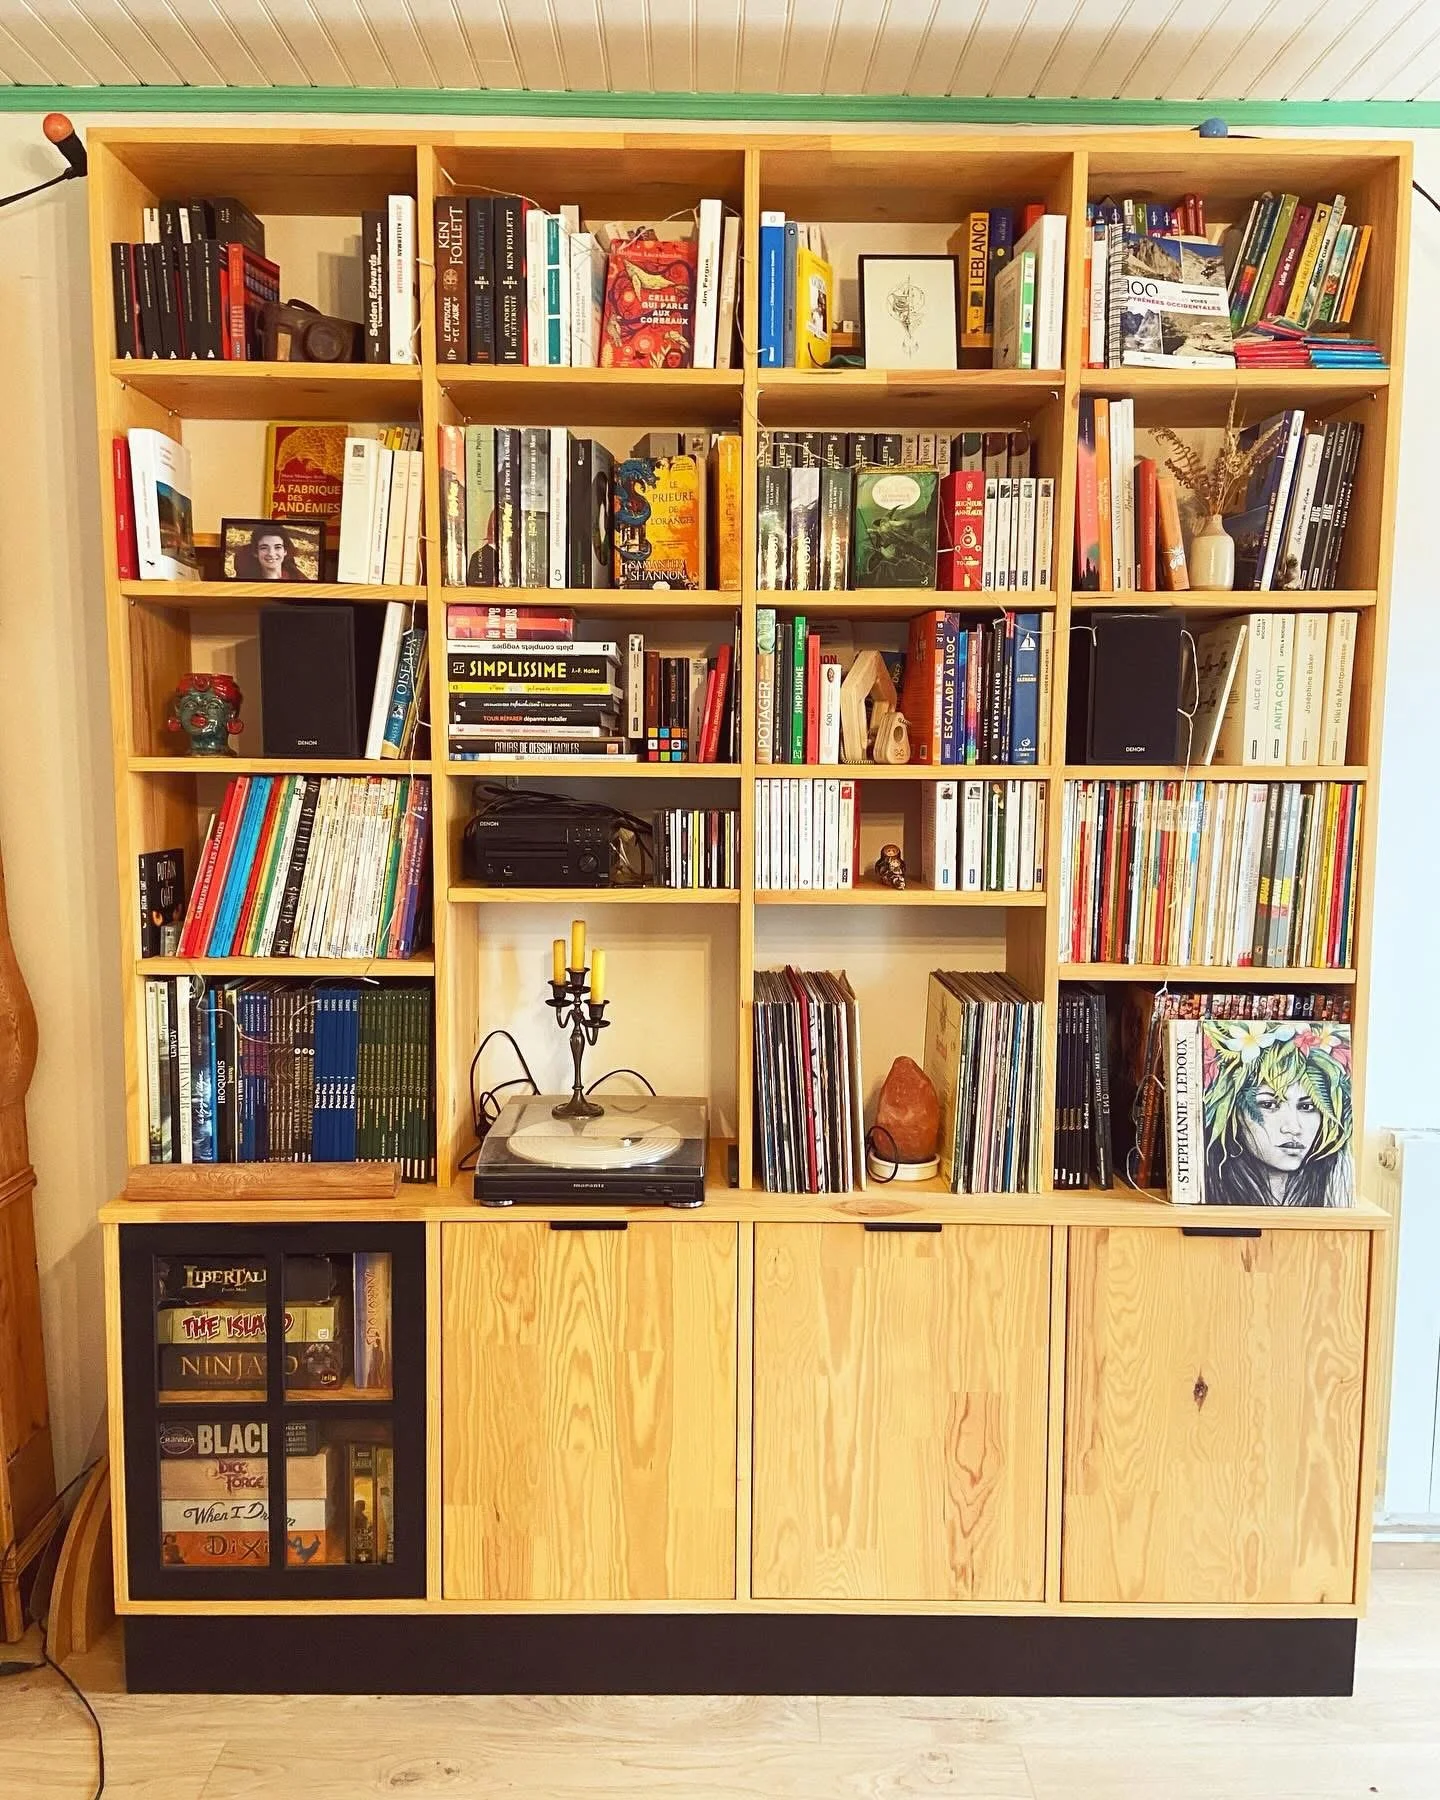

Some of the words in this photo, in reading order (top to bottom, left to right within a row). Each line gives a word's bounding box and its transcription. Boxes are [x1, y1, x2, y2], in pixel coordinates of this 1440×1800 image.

[439, 222, 449, 248] KEN
[450, 206, 463, 264] FOLLETT
[642, 302, 657, 310] QUI
[660, 302, 688, 310] PARLE
[648, 294, 676, 302] CELLE
[1166, 302, 1221, 311] OCCIDENTALES
[640, 316, 688, 325] CORBEAUX
[288, 484, 342, 496] FABRIQUE
[288, 494, 303, 502] DES
[272, 499, 341, 513] PANDÉMIES
[668, 506, 678, 514] DE
[1310, 506, 1322, 523] BUG
[1322, 504, 1334, 521] BUG
[631, 560, 687, 570] SAMANTHA
[631, 571, 685, 581] SHANNON
[501, 623, 518, 639] des
[946, 636, 956, 664] BLOC
[397, 637, 418, 695] OISEAUX
[469, 660, 567, 678] SIMPLISSIME
[946, 667, 954, 678] À
[1338, 643, 1348, 696] Montparnasse
[796, 666, 804, 713] SIMPLISSIME
[1276, 665, 1287, 696] CONTI
[944, 680, 954, 738] ESCALADE
[1336, 696, 1342, 707] de
[757, 680, 772, 747] POTAGER
[1274, 698, 1284, 730] ANITA
[494, 742, 518, 753] COURS
[519, 742, 528, 753] DE
[528, 742, 552, 754] DESSIN
[553, 743, 580, 754] FACILES
[212, 821, 225, 850] ALPAGES
[210, 851, 218, 864] LES
[204, 864, 214, 884] DANS
[194, 882, 209, 920] CAROLINE
[1176, 1038, 1188, 1094] LEDOUX
[218, 1060, 226, 1104] IROQUOIS
[1102, 1093, 1110, 1114] END
[1176, 1101, 1190, 1184] STEPHANIE
[182, 1264, 267, 1289] LIBERTALI
[182, 1314, 220, 1340] THE
[225, 1311, 294, 1338] ISLAD
[181, 1352, 298, 1382] NINJAO
[226, 1474, 265, 1496] FORGE
[183, 1502, 229, 1526] When
[230, 1506, 246, 1519] I
[243, 1502, 296, 1526] Drm
